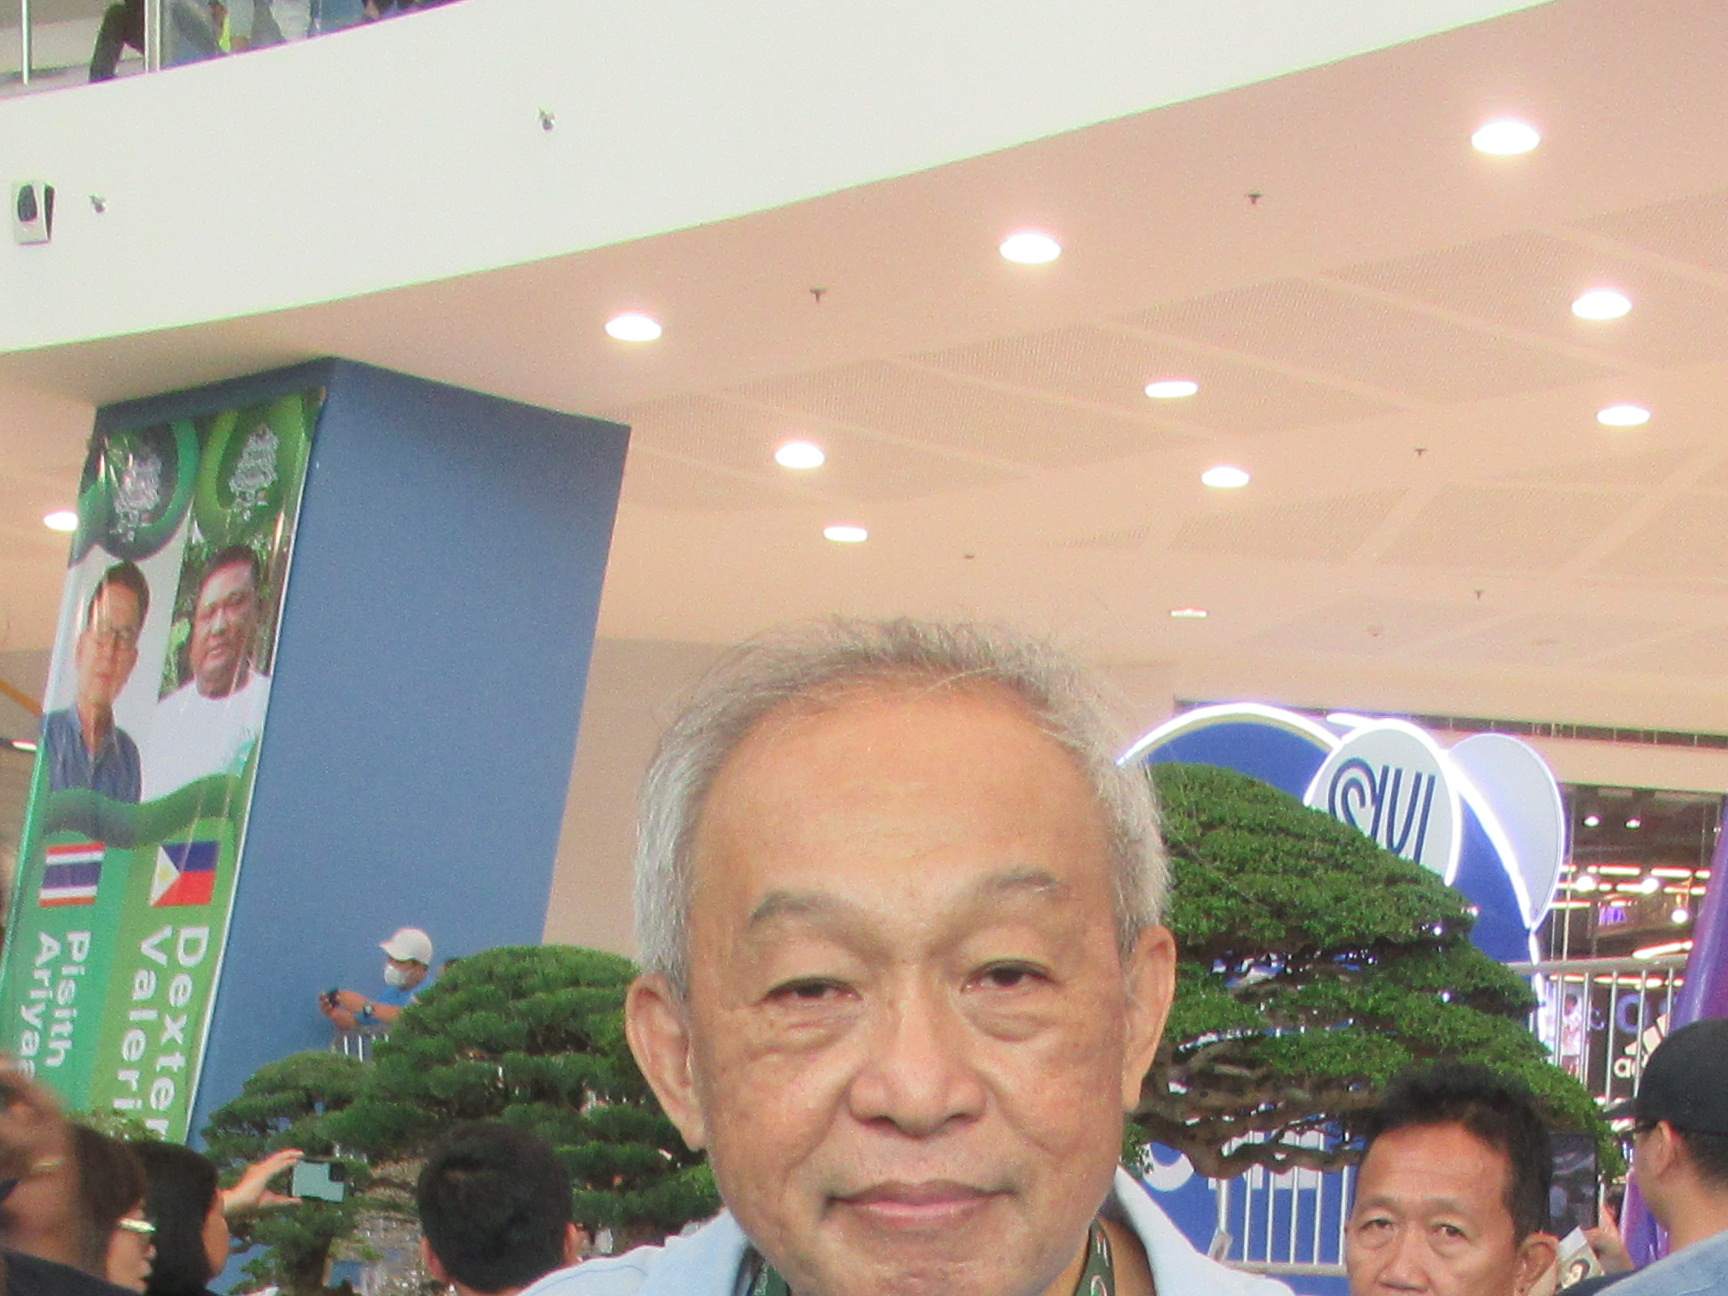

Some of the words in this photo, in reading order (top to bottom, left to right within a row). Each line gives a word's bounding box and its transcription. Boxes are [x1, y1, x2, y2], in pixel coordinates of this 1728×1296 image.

[44, 930, 91, 1068] Pisith
[113, 925, 172, 1110] Valeri
[145, 926, 210, 1139] Dexter
